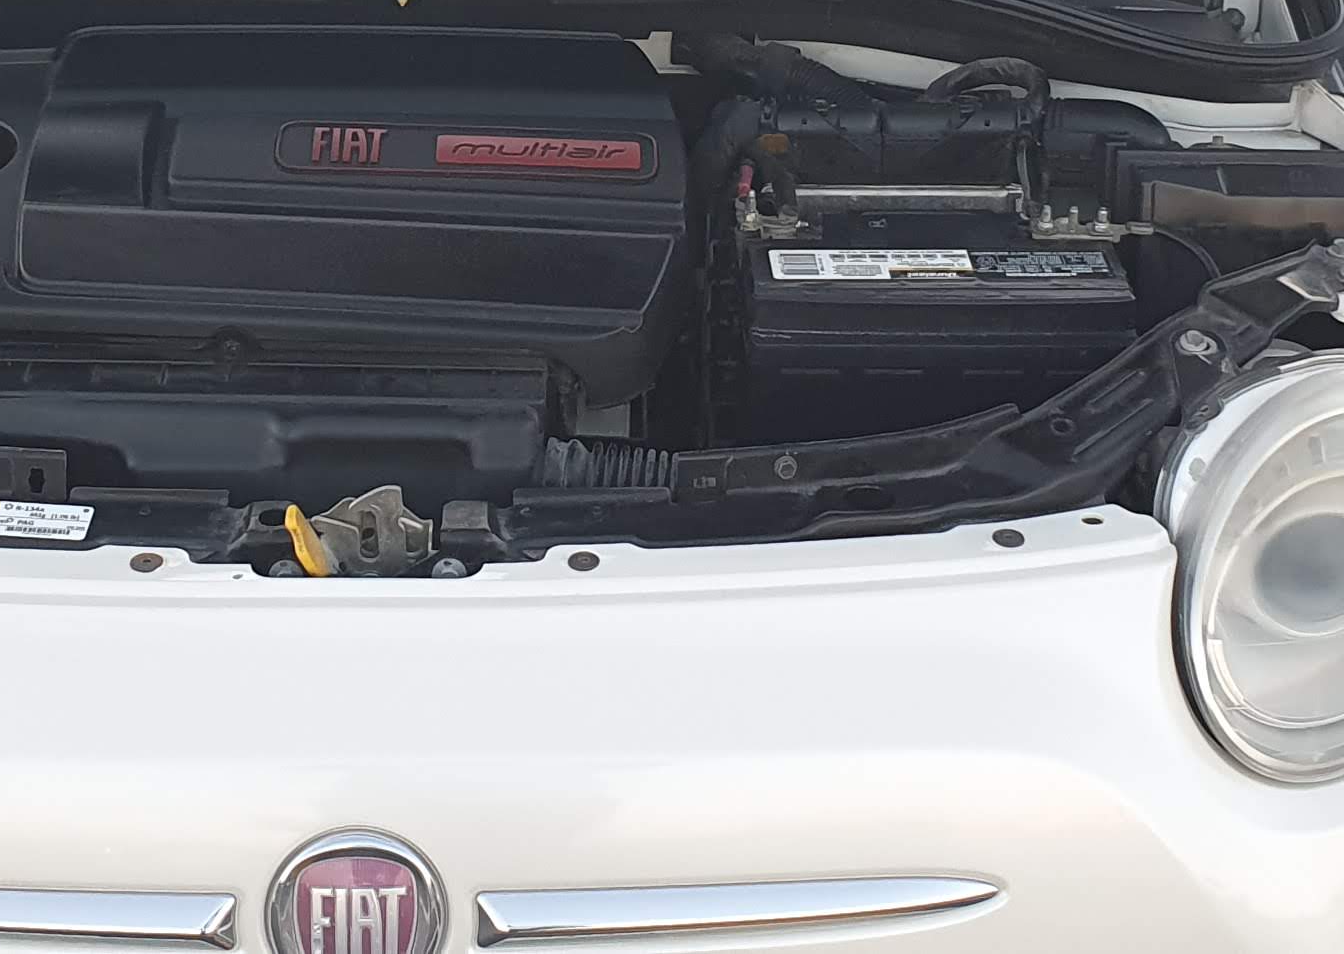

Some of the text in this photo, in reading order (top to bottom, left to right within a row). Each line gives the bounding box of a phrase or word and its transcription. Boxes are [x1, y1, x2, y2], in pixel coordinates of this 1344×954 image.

[311, 126, 628, 164] FIAT multiair
[311, 886, 407, 954] FIAT
